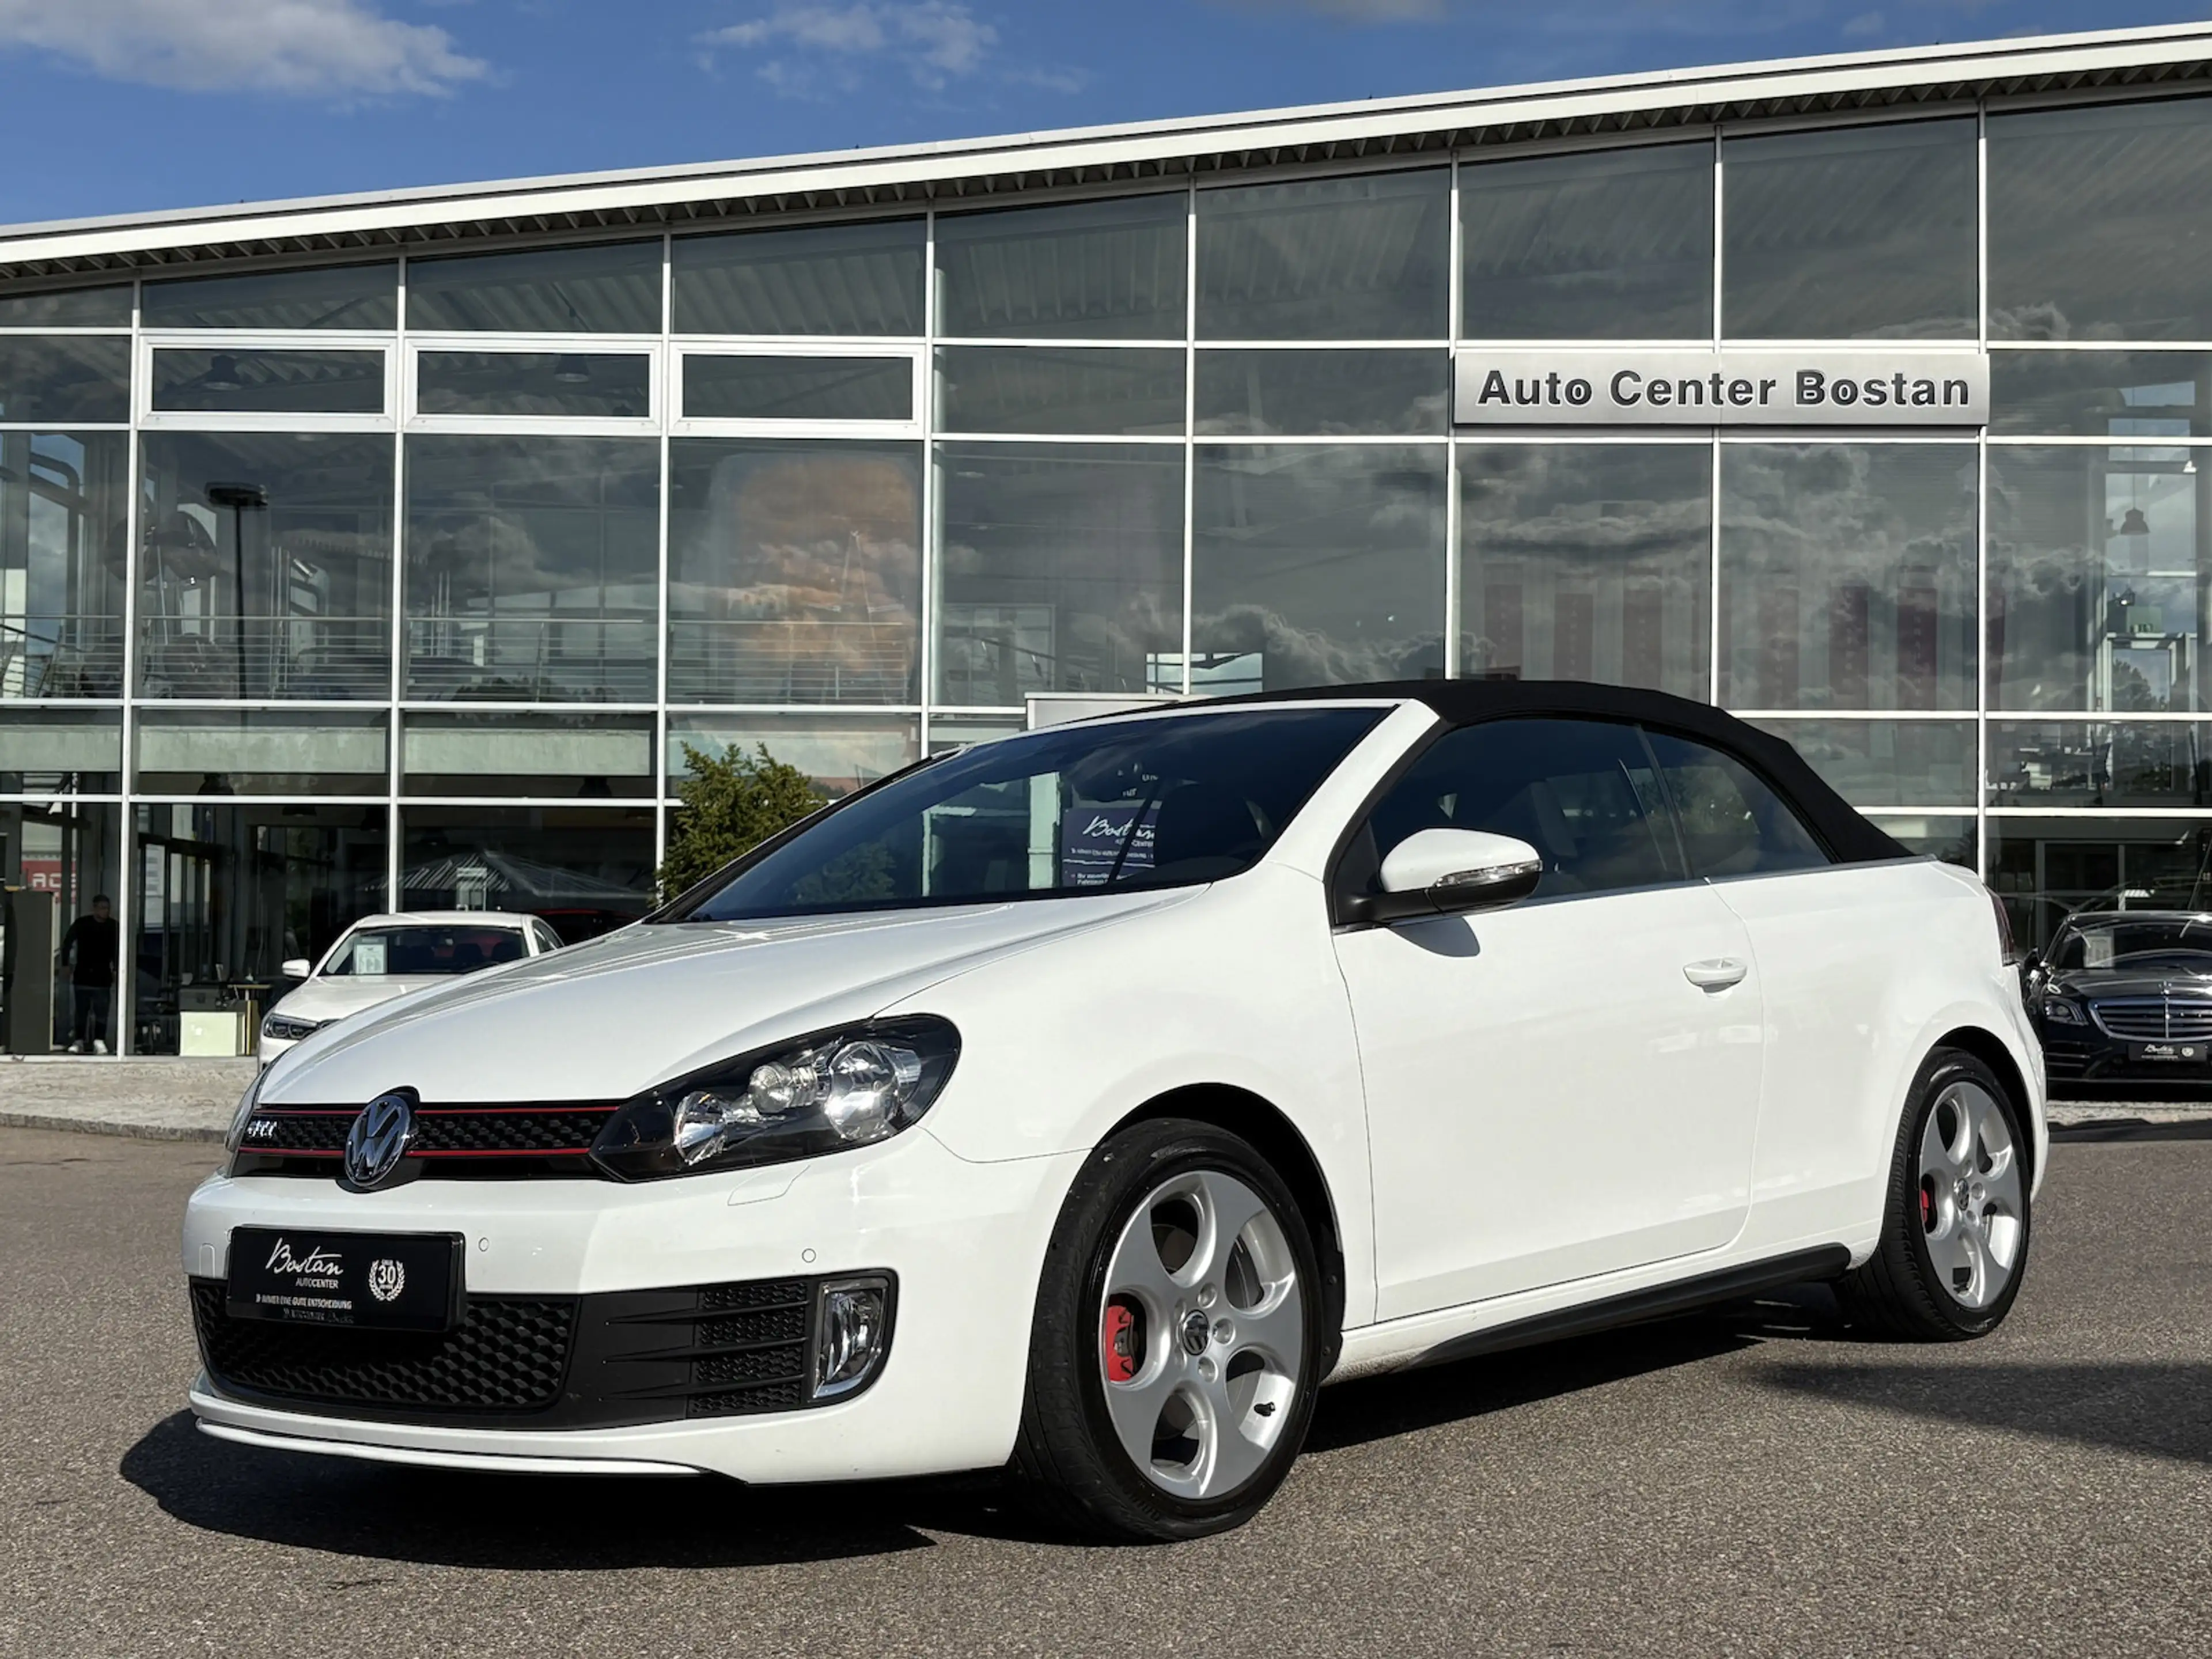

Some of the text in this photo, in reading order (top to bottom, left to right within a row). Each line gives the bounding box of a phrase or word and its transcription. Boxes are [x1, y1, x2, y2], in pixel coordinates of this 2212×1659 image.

[1476, 369, 1970, 407] Auto Center Bostan
[265, 1237, 344, 1275] Bostan
[295, 1277, 339, 1289] AUTOCENTER
[377, 1264, 396, 1285] 30
